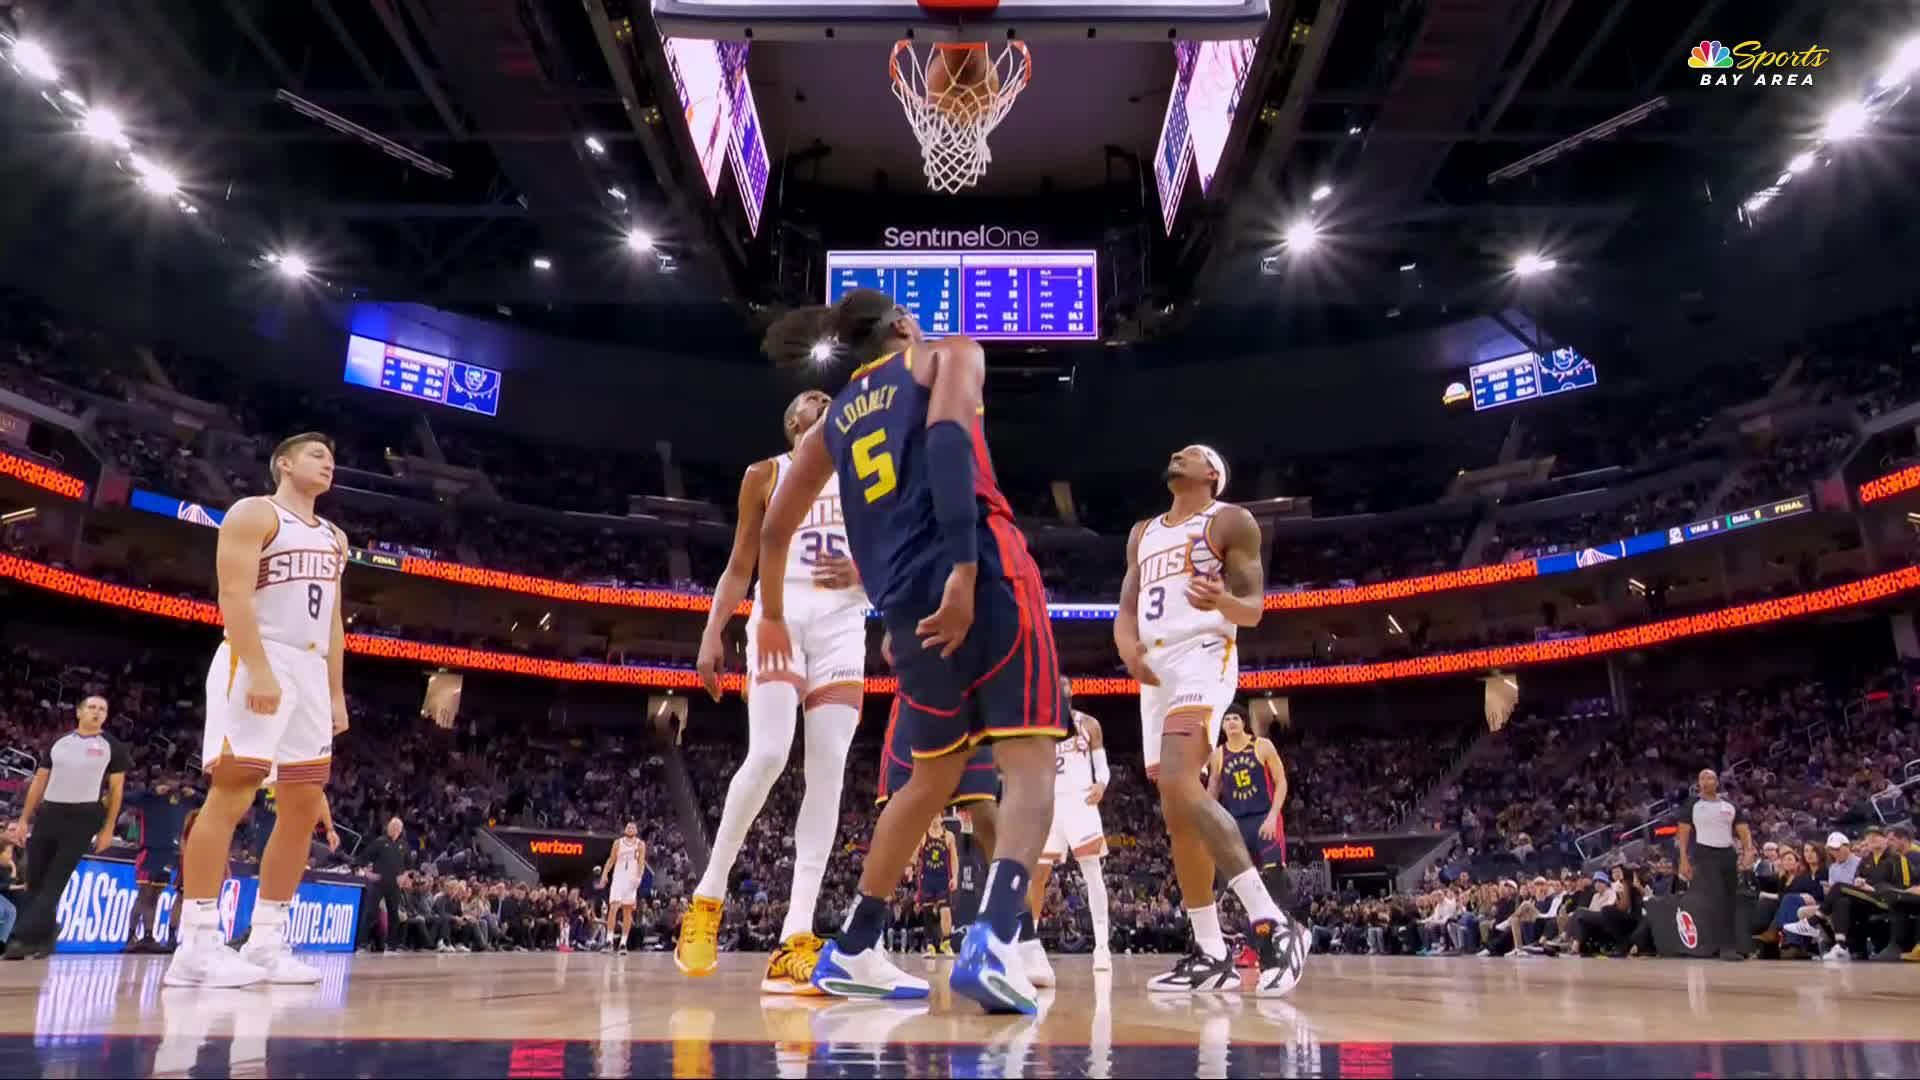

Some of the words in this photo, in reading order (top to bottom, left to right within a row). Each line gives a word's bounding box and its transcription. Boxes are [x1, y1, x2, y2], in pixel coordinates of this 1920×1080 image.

[884, 225, 1039, 247] SentinelOne
[834, 384, 898, 434] LOONEY
[851, 427, 897, 505] 5
[800, 530, 846, 566] 35
[266, 551, 337, 585] SUNS
[307, 583, 323, 620] 8
[1145, 586, 1166, 621] 3
[1232, 769, 1252, 788] 15
[530, 840, 583, 855] verizon
[1322, 844, 1375, 859] verizon
